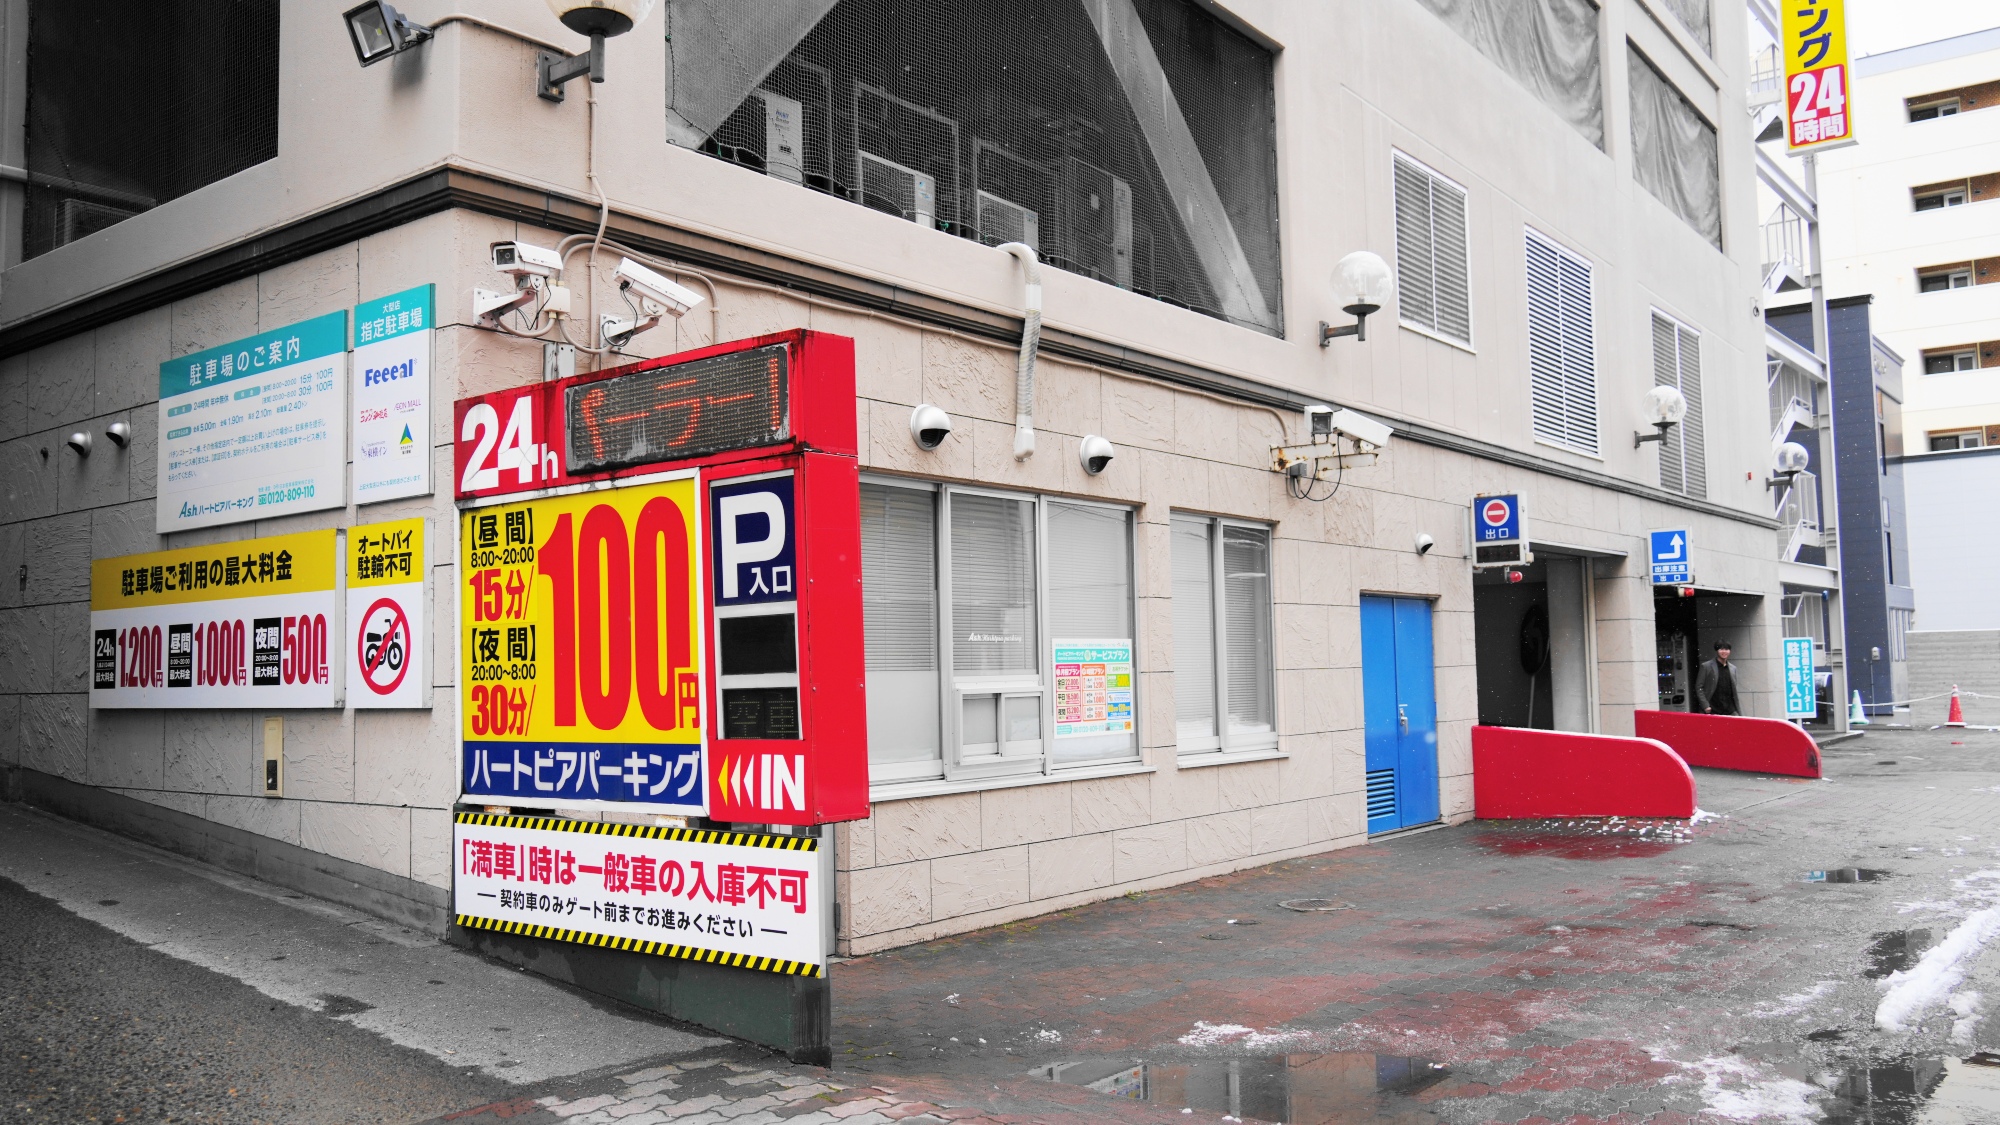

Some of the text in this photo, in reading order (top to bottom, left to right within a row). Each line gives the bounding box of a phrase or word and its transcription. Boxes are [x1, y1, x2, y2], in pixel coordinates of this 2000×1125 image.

[1797, 0, 1832, 69] ング
[1790, 66, 1844, 123] 24
[1794, 113, 1844, 144] 時間
[382, 301, 401, 314] 大型店
[361, 307, 422, 342] 指定駐車場
[190, 336, 300, 386] 駐車場のご案内
[300, 373, 312, 384] 15分
[316, 368, 333, 379] 100円
[299, 385, 312, 397] 30分
[316, 380, 333, 392] 100円
[461, 396, 559, 493] 24h
[178, 496, 254, 519] Ash ハートピアパーキング
[358, 530, 413, 554] オートバイ
[720, 491, 786, 599] P
[1485, 528, 1509, 539] 出口
[121, 550, 292, 596] 駐車場ご利用の最大料金
[357, 551, 413, 579] 駐輪不可
[749, 565, 792, 596] 入口
[1660, 574, 1681, 582] 出口
[538, 496, 700, 731] 100円
[97, 637, 114, 657] 24h
[170, 632, 191, 654] 昼間
[194, 619, 246, 687] 1,000円
[255, 626, 279, 650] 夜間
[283, 613, 328, 685] 500円
[118, 624, 163, 689] 1,200円
[1090, 650, 1129, 660] サービスプラン
[95, 671, 114, 683] 最大料金
[169, 668, 190, 680] 最大料金
[254, 666, 279, 678] 最大料金
[1786, 642, 1803, 711] 駐車場入口
[471, 749, 700, 797] ハートピアパーキング
[761, 754, 806, 811] IN
[462, 838, 809, 914] 「満車」時は一般車の入庫不可
[500, 889, 753, 938] 契約車のみゲート前までお進みください
